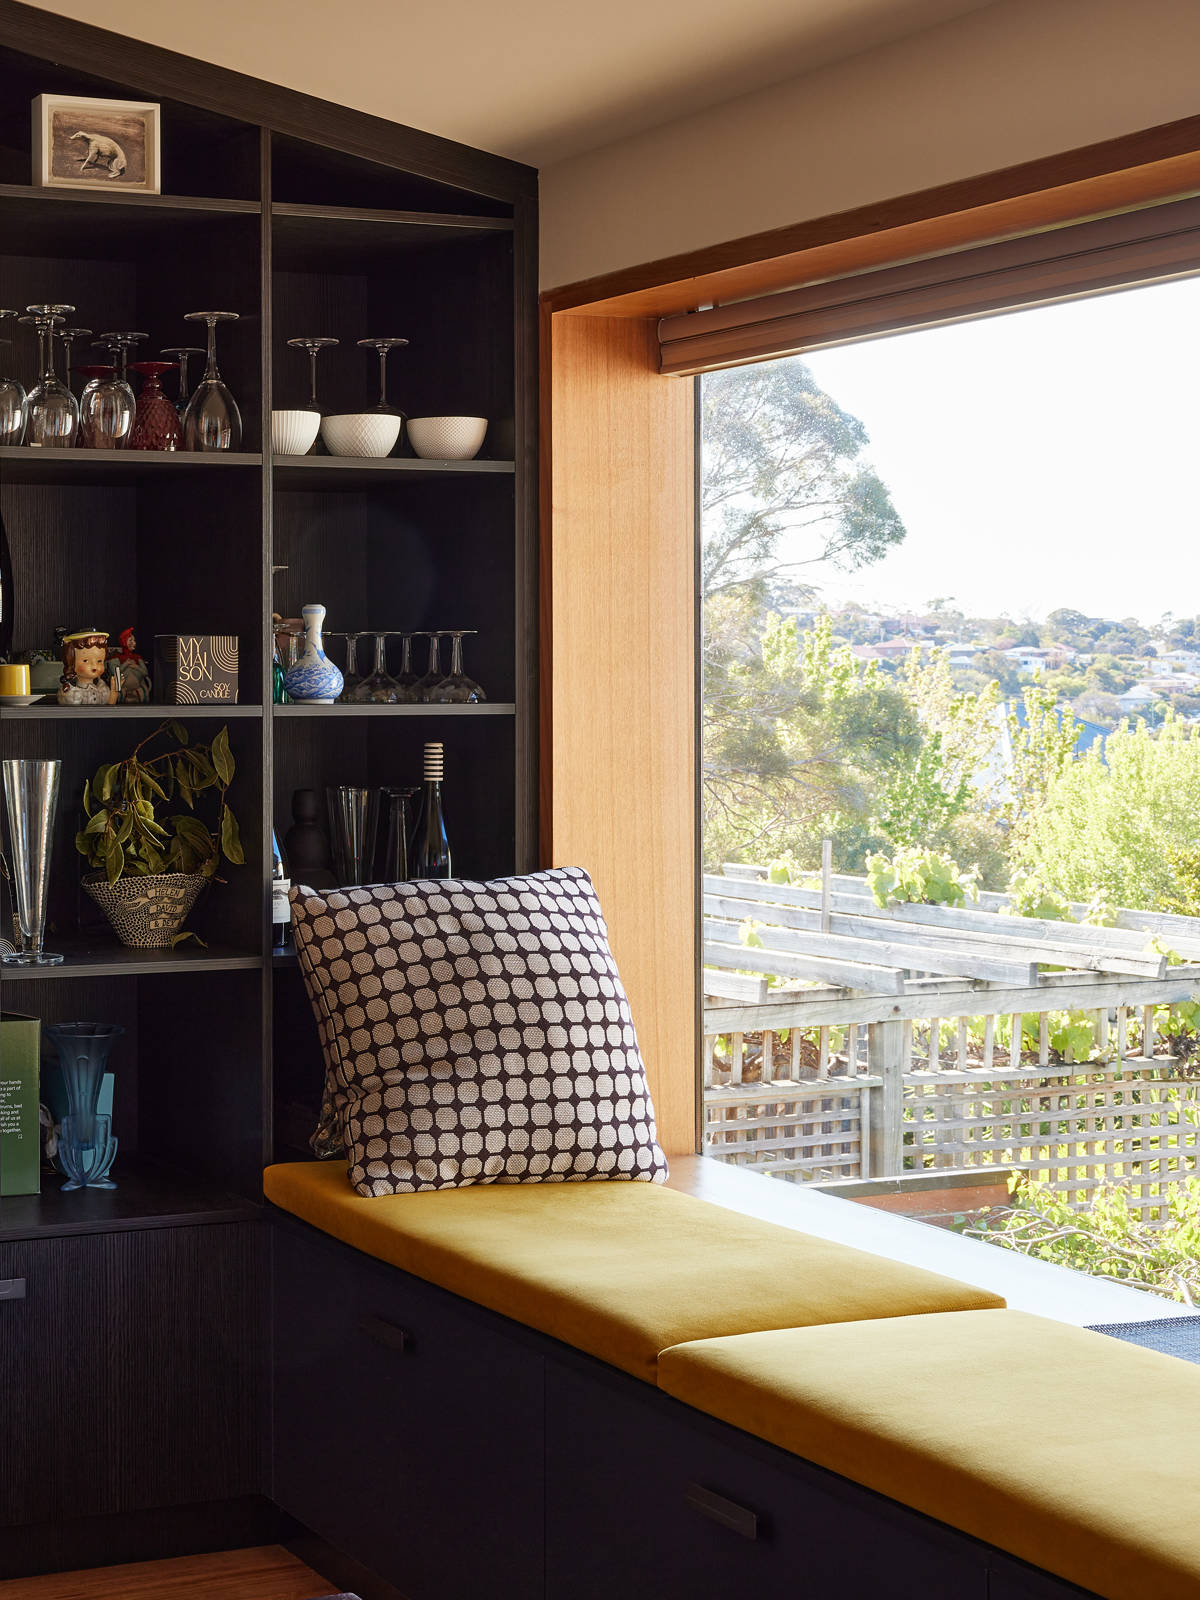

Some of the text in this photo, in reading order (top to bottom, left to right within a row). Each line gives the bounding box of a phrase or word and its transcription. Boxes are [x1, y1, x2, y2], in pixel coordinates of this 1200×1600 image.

[179, 637, 204, 653] MY
[179, 652, 207, 667] MAI
[179, 666, 213, 681] SON
[213, 682, 231, 692] SOY
[200, 690, 230, 699] CANDLE
[155, 889, 181, 898] HELEN
[156, 904, 178, 912] DAVID
